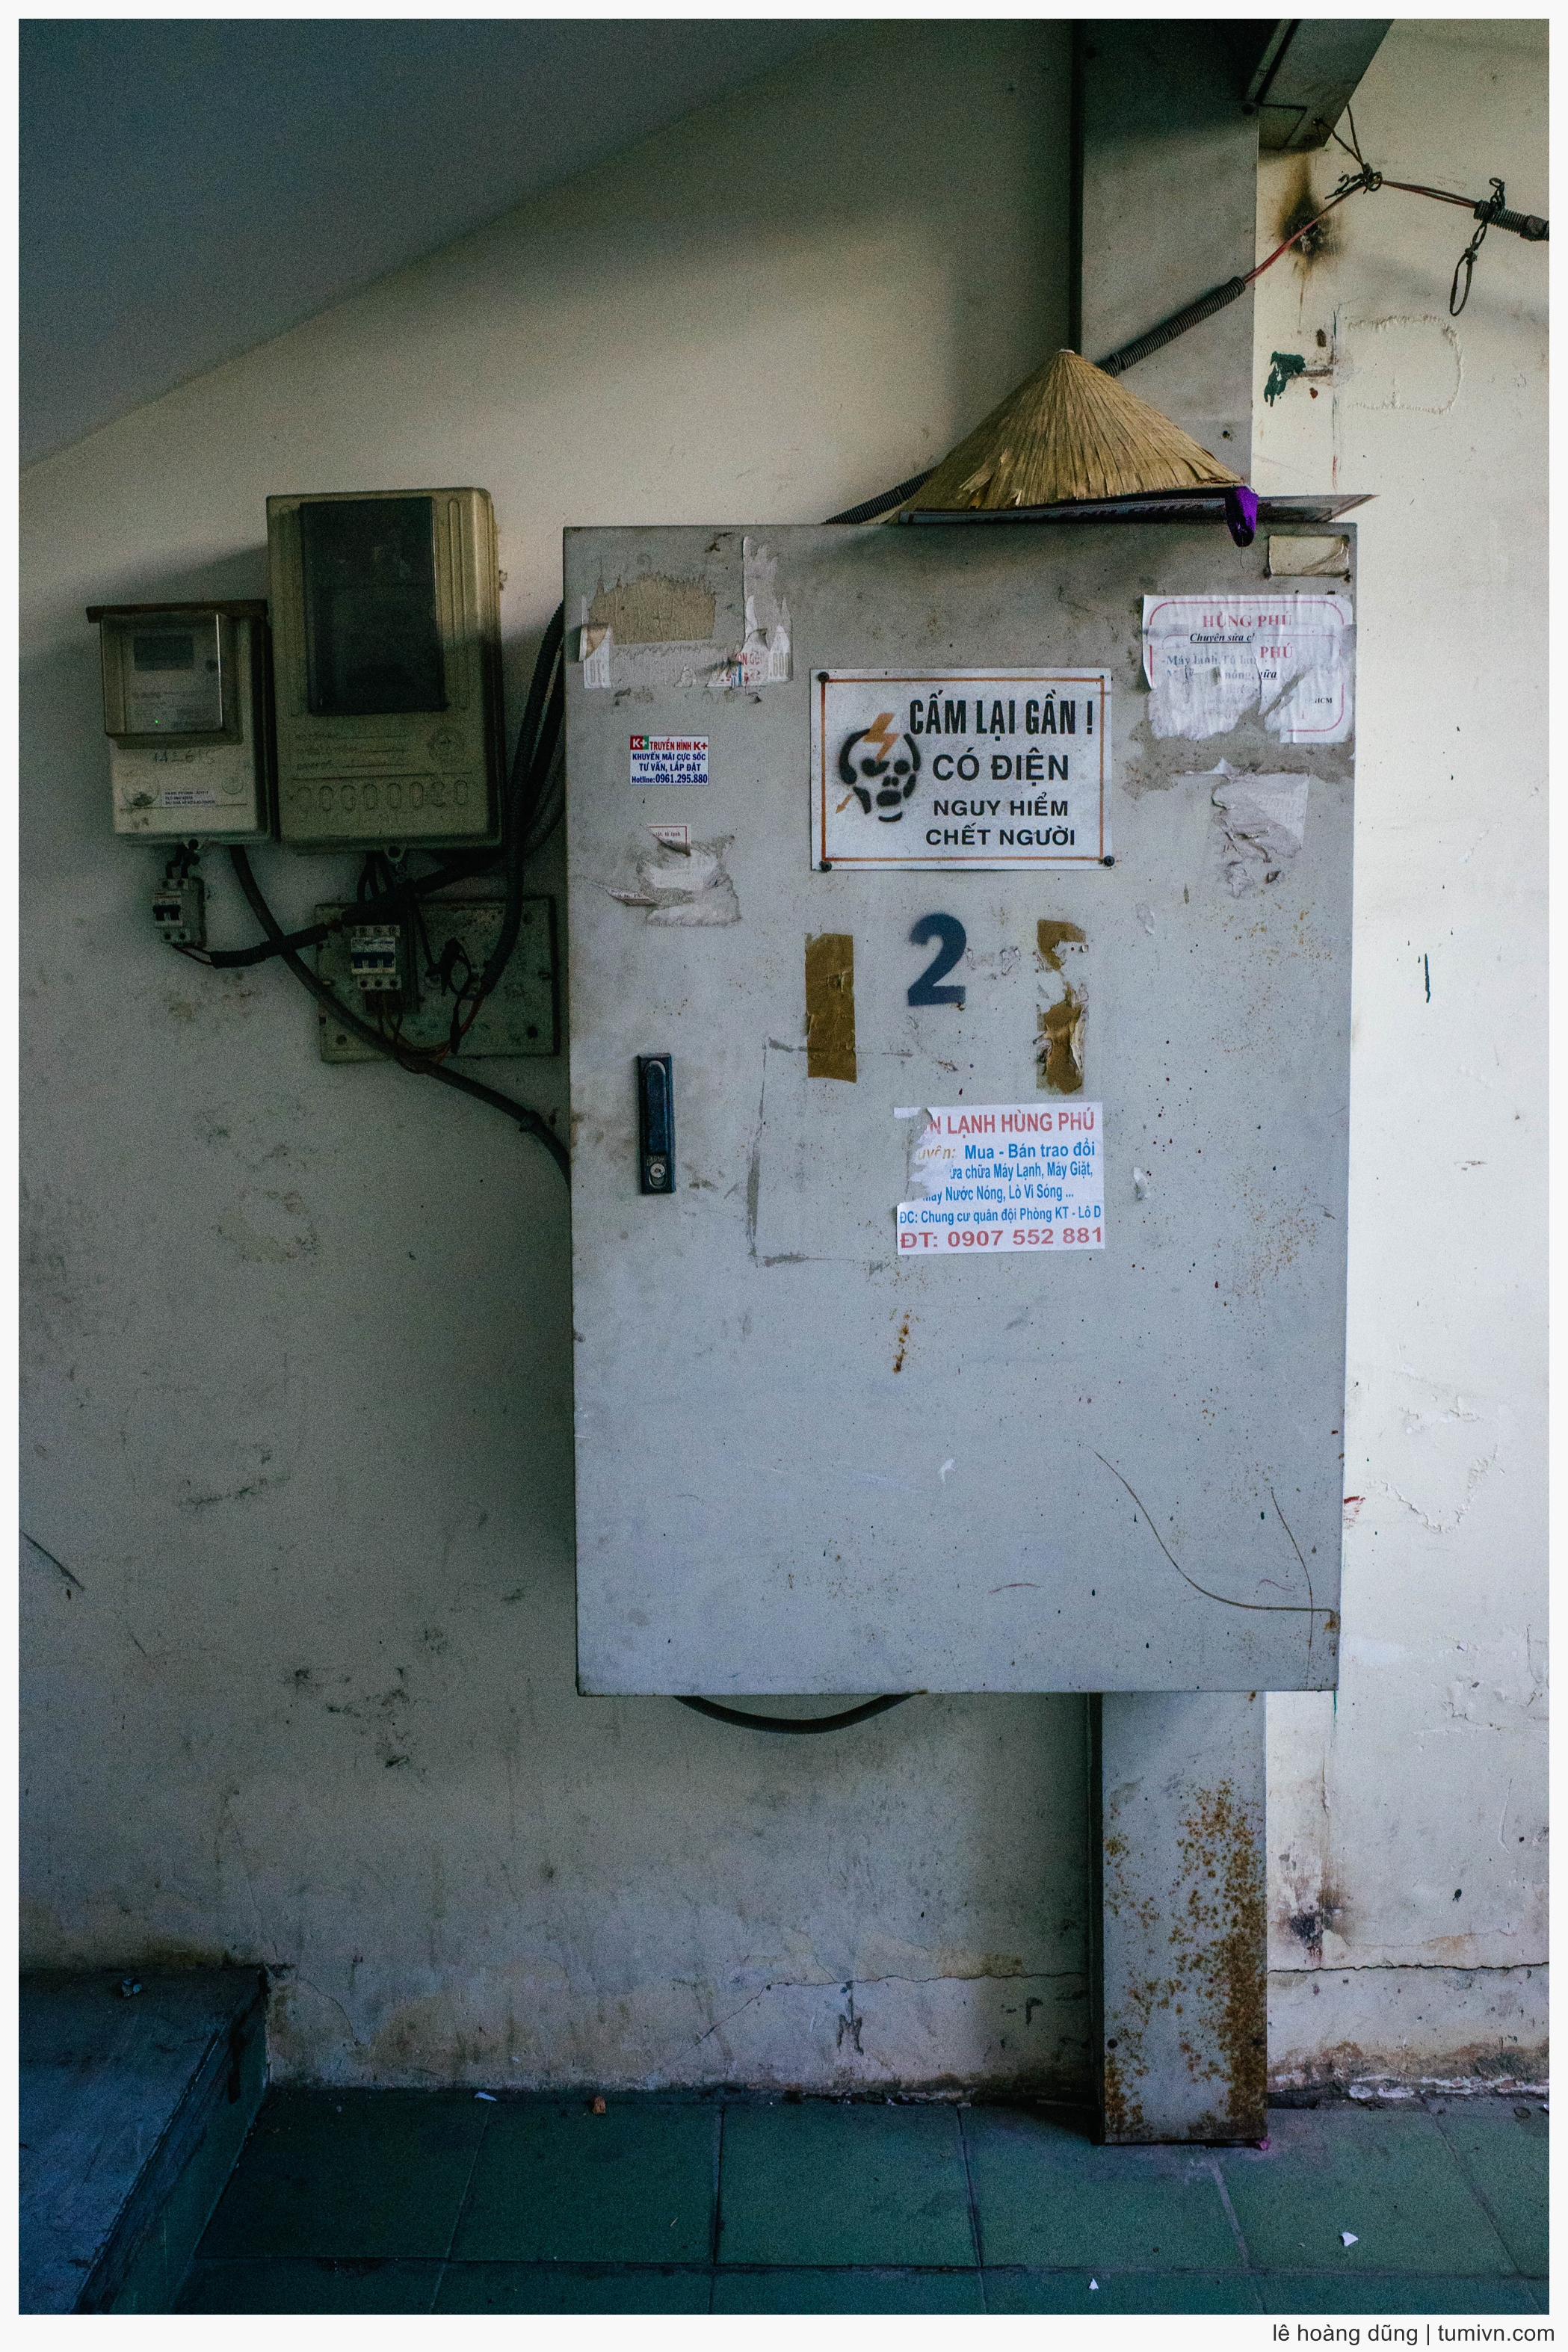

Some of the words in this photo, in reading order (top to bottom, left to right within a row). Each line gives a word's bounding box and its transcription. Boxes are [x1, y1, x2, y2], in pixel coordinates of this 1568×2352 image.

[1259, 643, 1293, 659] PHÚ
[910, 689, 966, 735] CẤM
[976, 700, 1016, 741] LẠI
[1025, 688, 1076, 735] GẦN
[649, 738, 675, 751] TRUYỀN
[676, 739, 691, 751] HÌNH
[694, 741, 709, 750] K+
[632, 751, 660, 761] KHUYẾN
[661, 752, 675, 761] MÃI
[676, 753, 691, 762] CỰC
[692, 751, 706, 761] SỐC
[639, 762, 649, 771] TƯ
[651, 760, 667, 773] VẤN,
[670, 761, 685, 771] LẮP
[686, 762, 701, 774] ĐẶT
[932, 747, 980, 781] CÓ
[990, 747, 1069, 786] ĐIỆN
[933, 800, 1001, 817] NGUY
[1010, 791, 1069, 817] HIỂM
[925, 822, 991, 846] CHẾT
[999, 824, 1075, 846] NGƯỜI
[908, 913, 967, 1007] 2
[947, 1114, 996, 1138] LẠNH
[1001, 1109, 1052, 1132] HÙNG
[1058, 1107, 1094, 1131] PHÚ
[965, 1144, 995, 1159] Mua
[1008, 1143, 1037, 1158] Bán
[1040, 1144, 1069, 1158] trao
[1073, 1138, 1096, 1157] đổi
[966, 1164, 991, 1179] chữa
[994, 1163, 1014, 1181] Máy
[1016, 1163, 1045, 1181] Lạnh,
[1047, 1161, 1067, 1180] Máy
[1070, 1161, 1093, 1180] Giặt,
[945, 1185, 974, 1201] Nước
[976, 1185, 1006, 1203] Nóng,
[1009, 1185, 1022, 1200] Lò
[1024, 1184, 1034, 1199] Vi
[1037, 1184, 1063, 1202] Sóng
[899, 1211, 919, 1224] ĐC:
[921, 1210, 954, 1226] Chung
[957, 1212, 972, 1223] cư
[974, 1209, 998, 1226] quân
[1001, 1208, 1017, 1226] đội
[1019, 1209, 1052, 1223] Phòng
[1055, 1206, 1069, 1219] KT
[1078, 1206, 1091, 1218] Lô
[1093, 1205, 1102, 1217] D
[899, 1232, 938, 1249] ĐT:
[948, 1229, 1004, 1247] 0907
[1013, 1228, 1055, 1245] 552
[1062, 1226, 1102, 1244] 881
